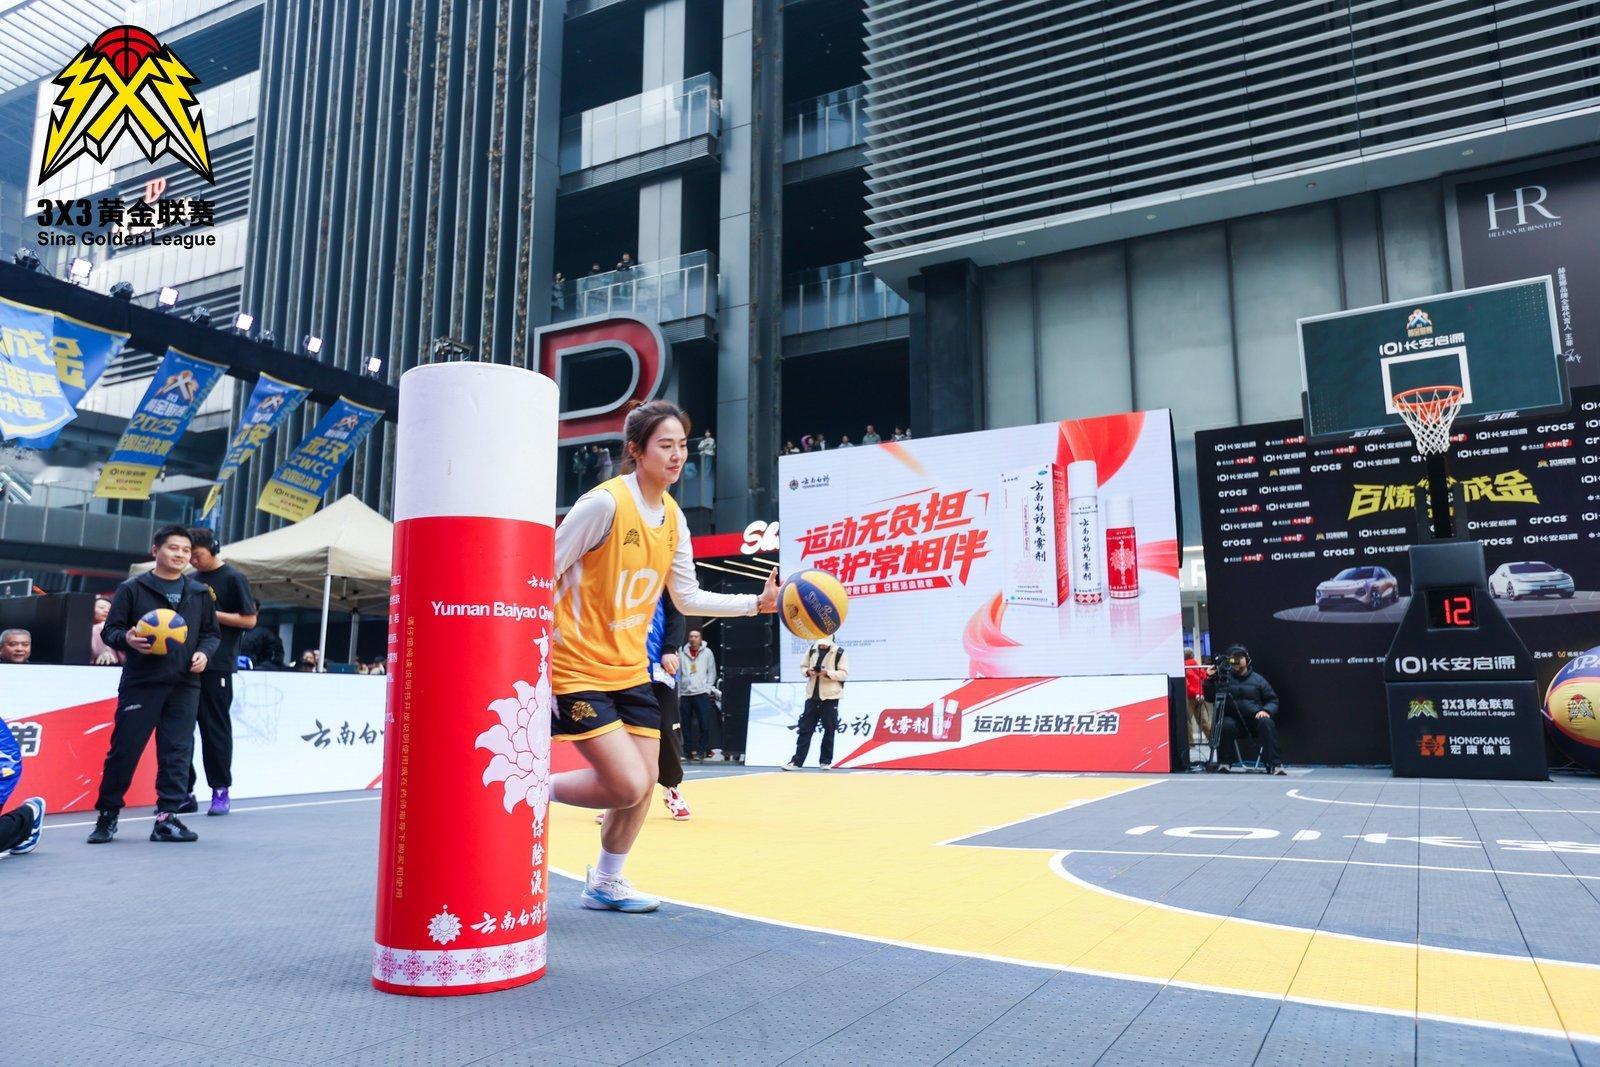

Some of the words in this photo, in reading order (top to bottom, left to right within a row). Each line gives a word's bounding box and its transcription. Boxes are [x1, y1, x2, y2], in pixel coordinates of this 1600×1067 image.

[1486, 185, 1561, 230] HR
[1488, 228, 1518, 239] HELENA
[1517, 221, 1562, 233] RUBINSTEIN
[129, 412, 182, 436] 2025
[1537, 422, 1575, 433] crocs
[1310, 462, 1342, 473] crocs
[1218, 488, 1248, 498] crocs
[1460, 469, 1540, 505] 成金
[794, 489, 975, 562] 运动无负担
[1030, 480, 1046, 562] 云南白药气雾剂
[1529, 514, 1568, 525] crocs
[1222, 538, 1252, 547] crocs
[1323, 548, 1355, 558] crocs
[614, 567, 659, 610] 10
[431, 601, 490, 617] Yunnan
[493, 602, 537, 621] Baiyao
[1444, 596, 1471, 625] 12
[1442, 709, 1459, 717] Sina
[1460, 709, 1487, 717] Golden
[301, 719, 386, 750] 云南白
[883, 716, 929, 735] 气雾剂
[974, 713, 1119, 734] 运动生活好兄弟
[1449, 736, 1510, 745] HONGKANG
[470, 902, 542, 934] 云南白药
